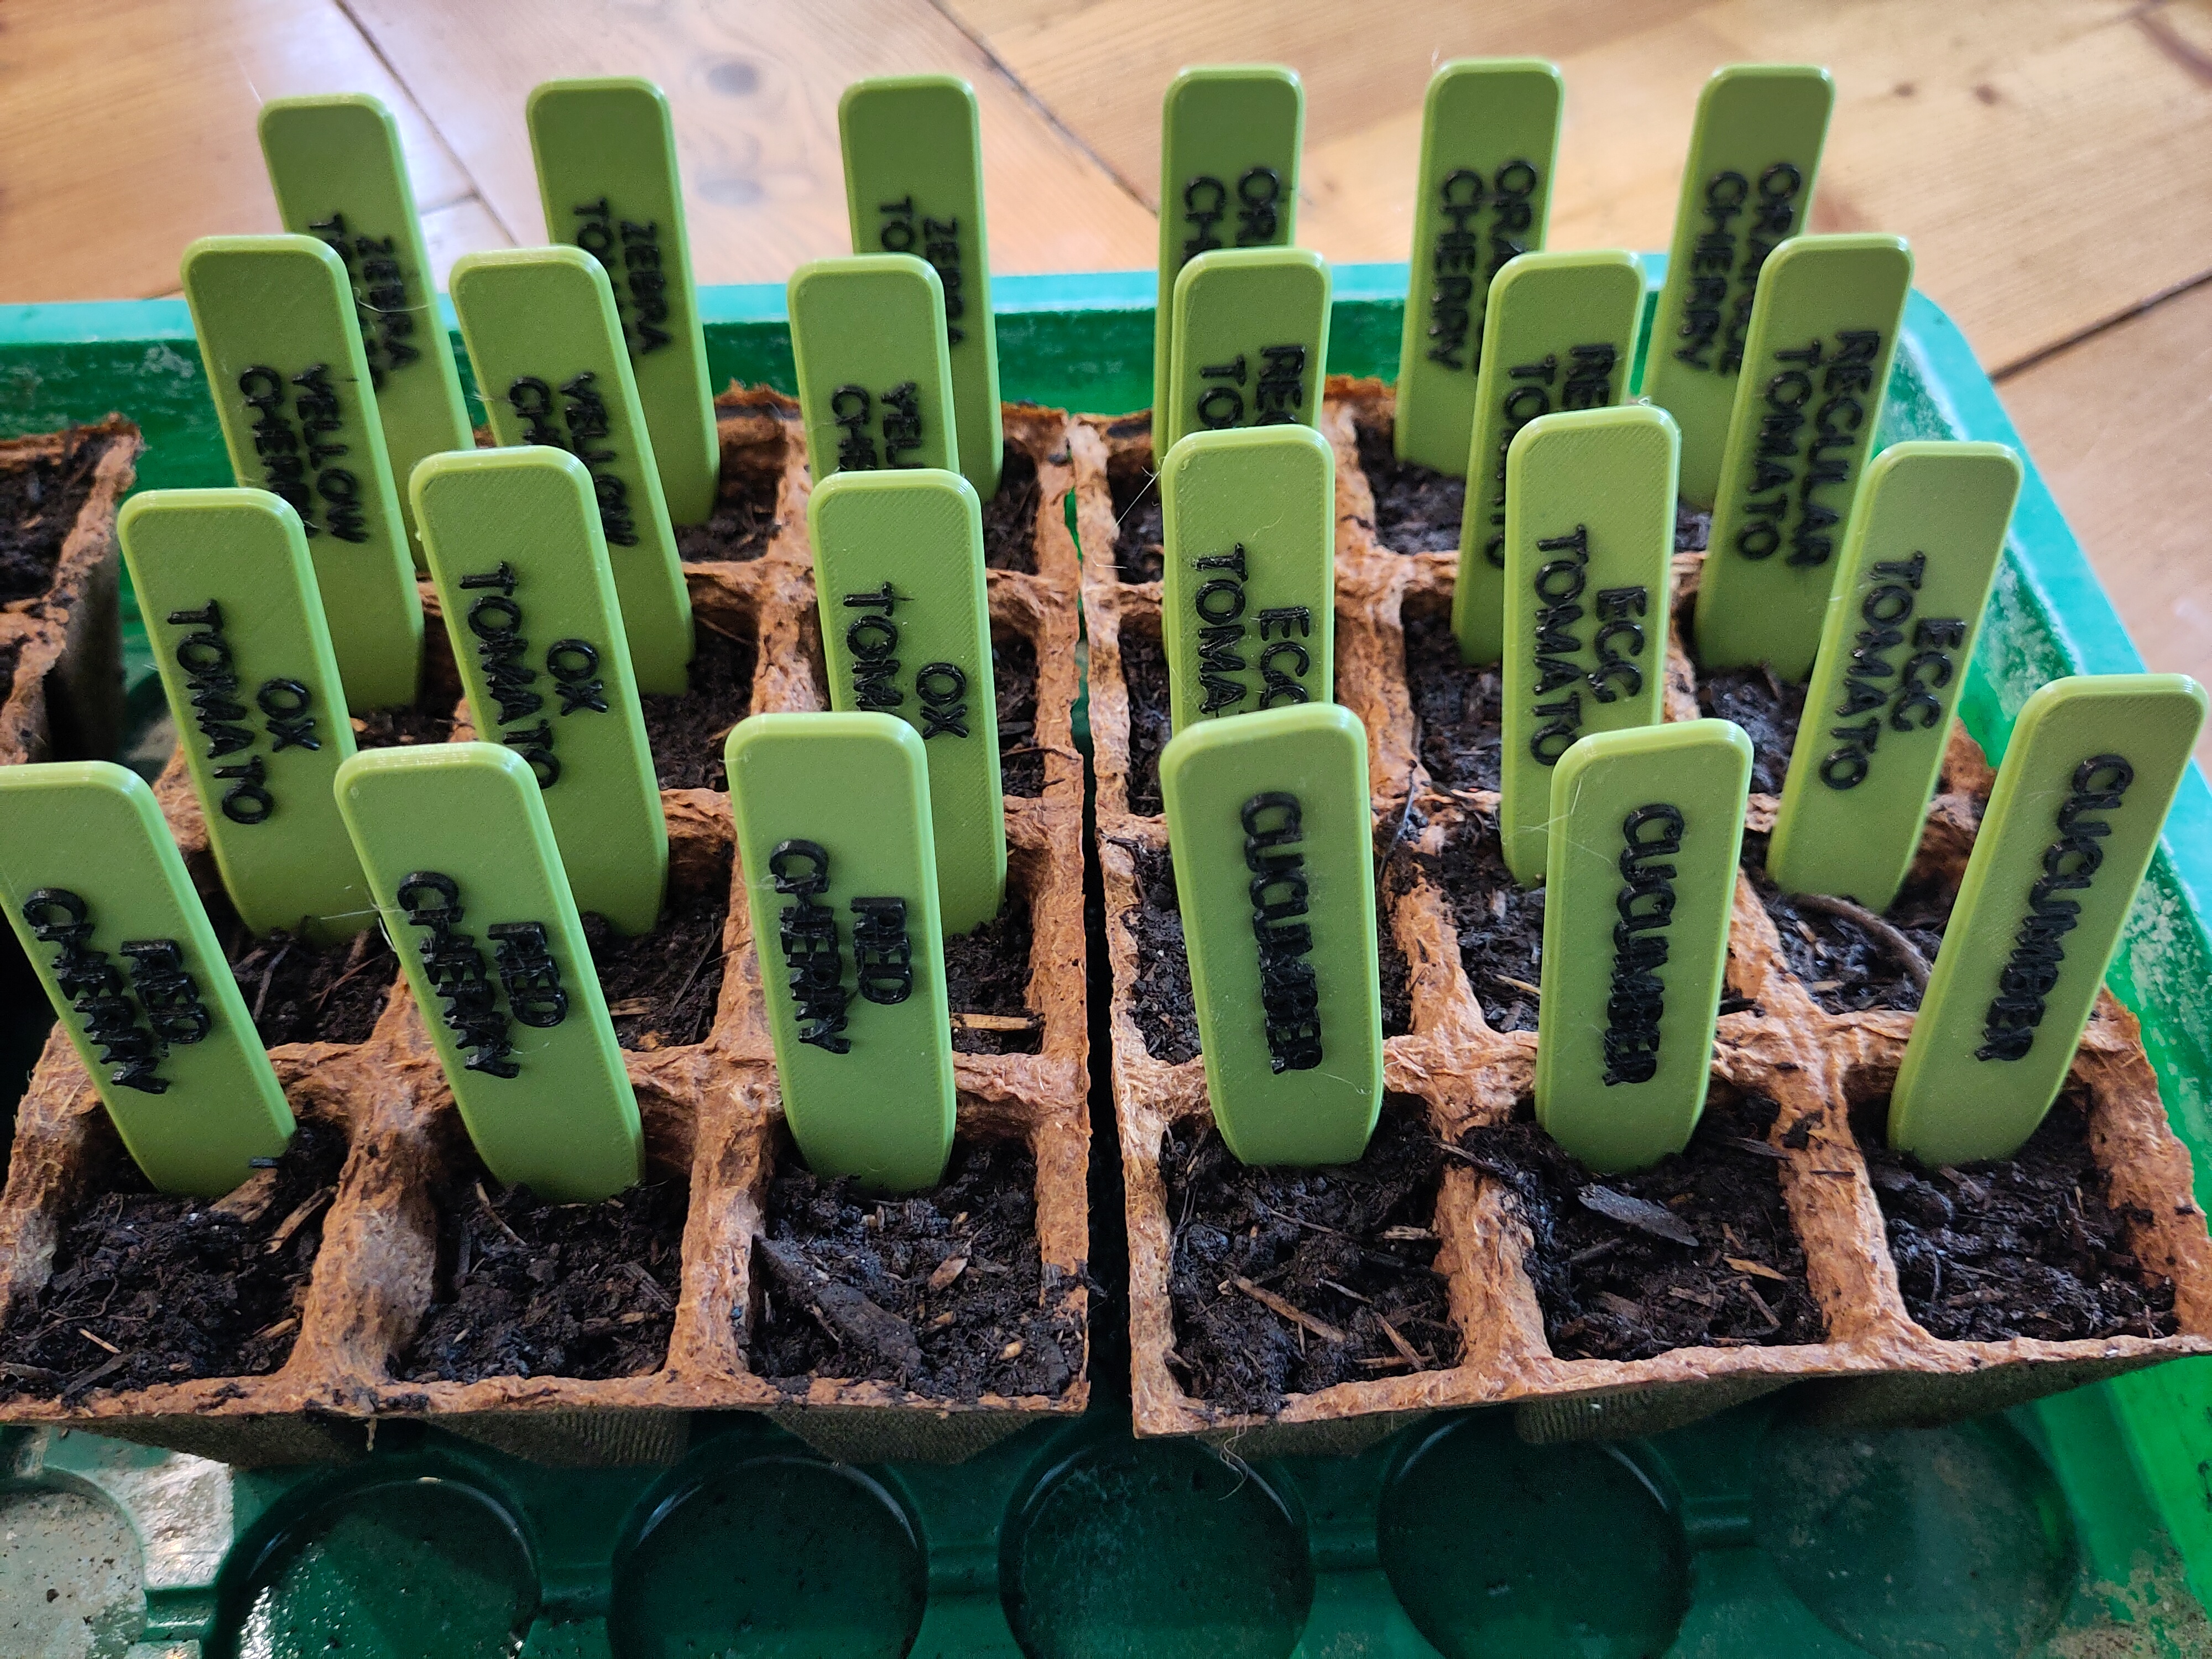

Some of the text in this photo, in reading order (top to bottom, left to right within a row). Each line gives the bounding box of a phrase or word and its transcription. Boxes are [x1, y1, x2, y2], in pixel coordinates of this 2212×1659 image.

[356, 234, 421, 372] ZEBRA
[620, 220, 672, 355] ZEBRA
[1427, 170, 1484, 371] CHERRY
[1674, 171, 1749, 371] CHERRY
[292, 364, 369, 544] YELLOW
[1736, 338, 1823, 561] TOMATO
[167, 598, 275, 825] TOMATO
[257, 679, 322, 752] OX
[547, 628, 608, 716] OX
[843, 581, 904, 712] TOM
[916, 662, 970, 740] OX
[1193, 542, 1249, 716] TOMA
[1530, 524, 1589, 766] TOMATO
[1820, 551, 1927, 790] TOMATO
[23, 888, 171, 1095] CHERRY
[120, 939, 211, 1045] RED
[397, 870, 520, 1079] CHERRY
[487, 922, 568, 1028] RED
[769, 839, 852, 1055] CHERRY
[851, 897, 912, 1005] RED
[1241, 791, 1323, 1074] CUCUMBER
[1602, 803, 1684, 1087] CUCUMBER
[1974, 754, 2134, 1061] CUCUMBER
